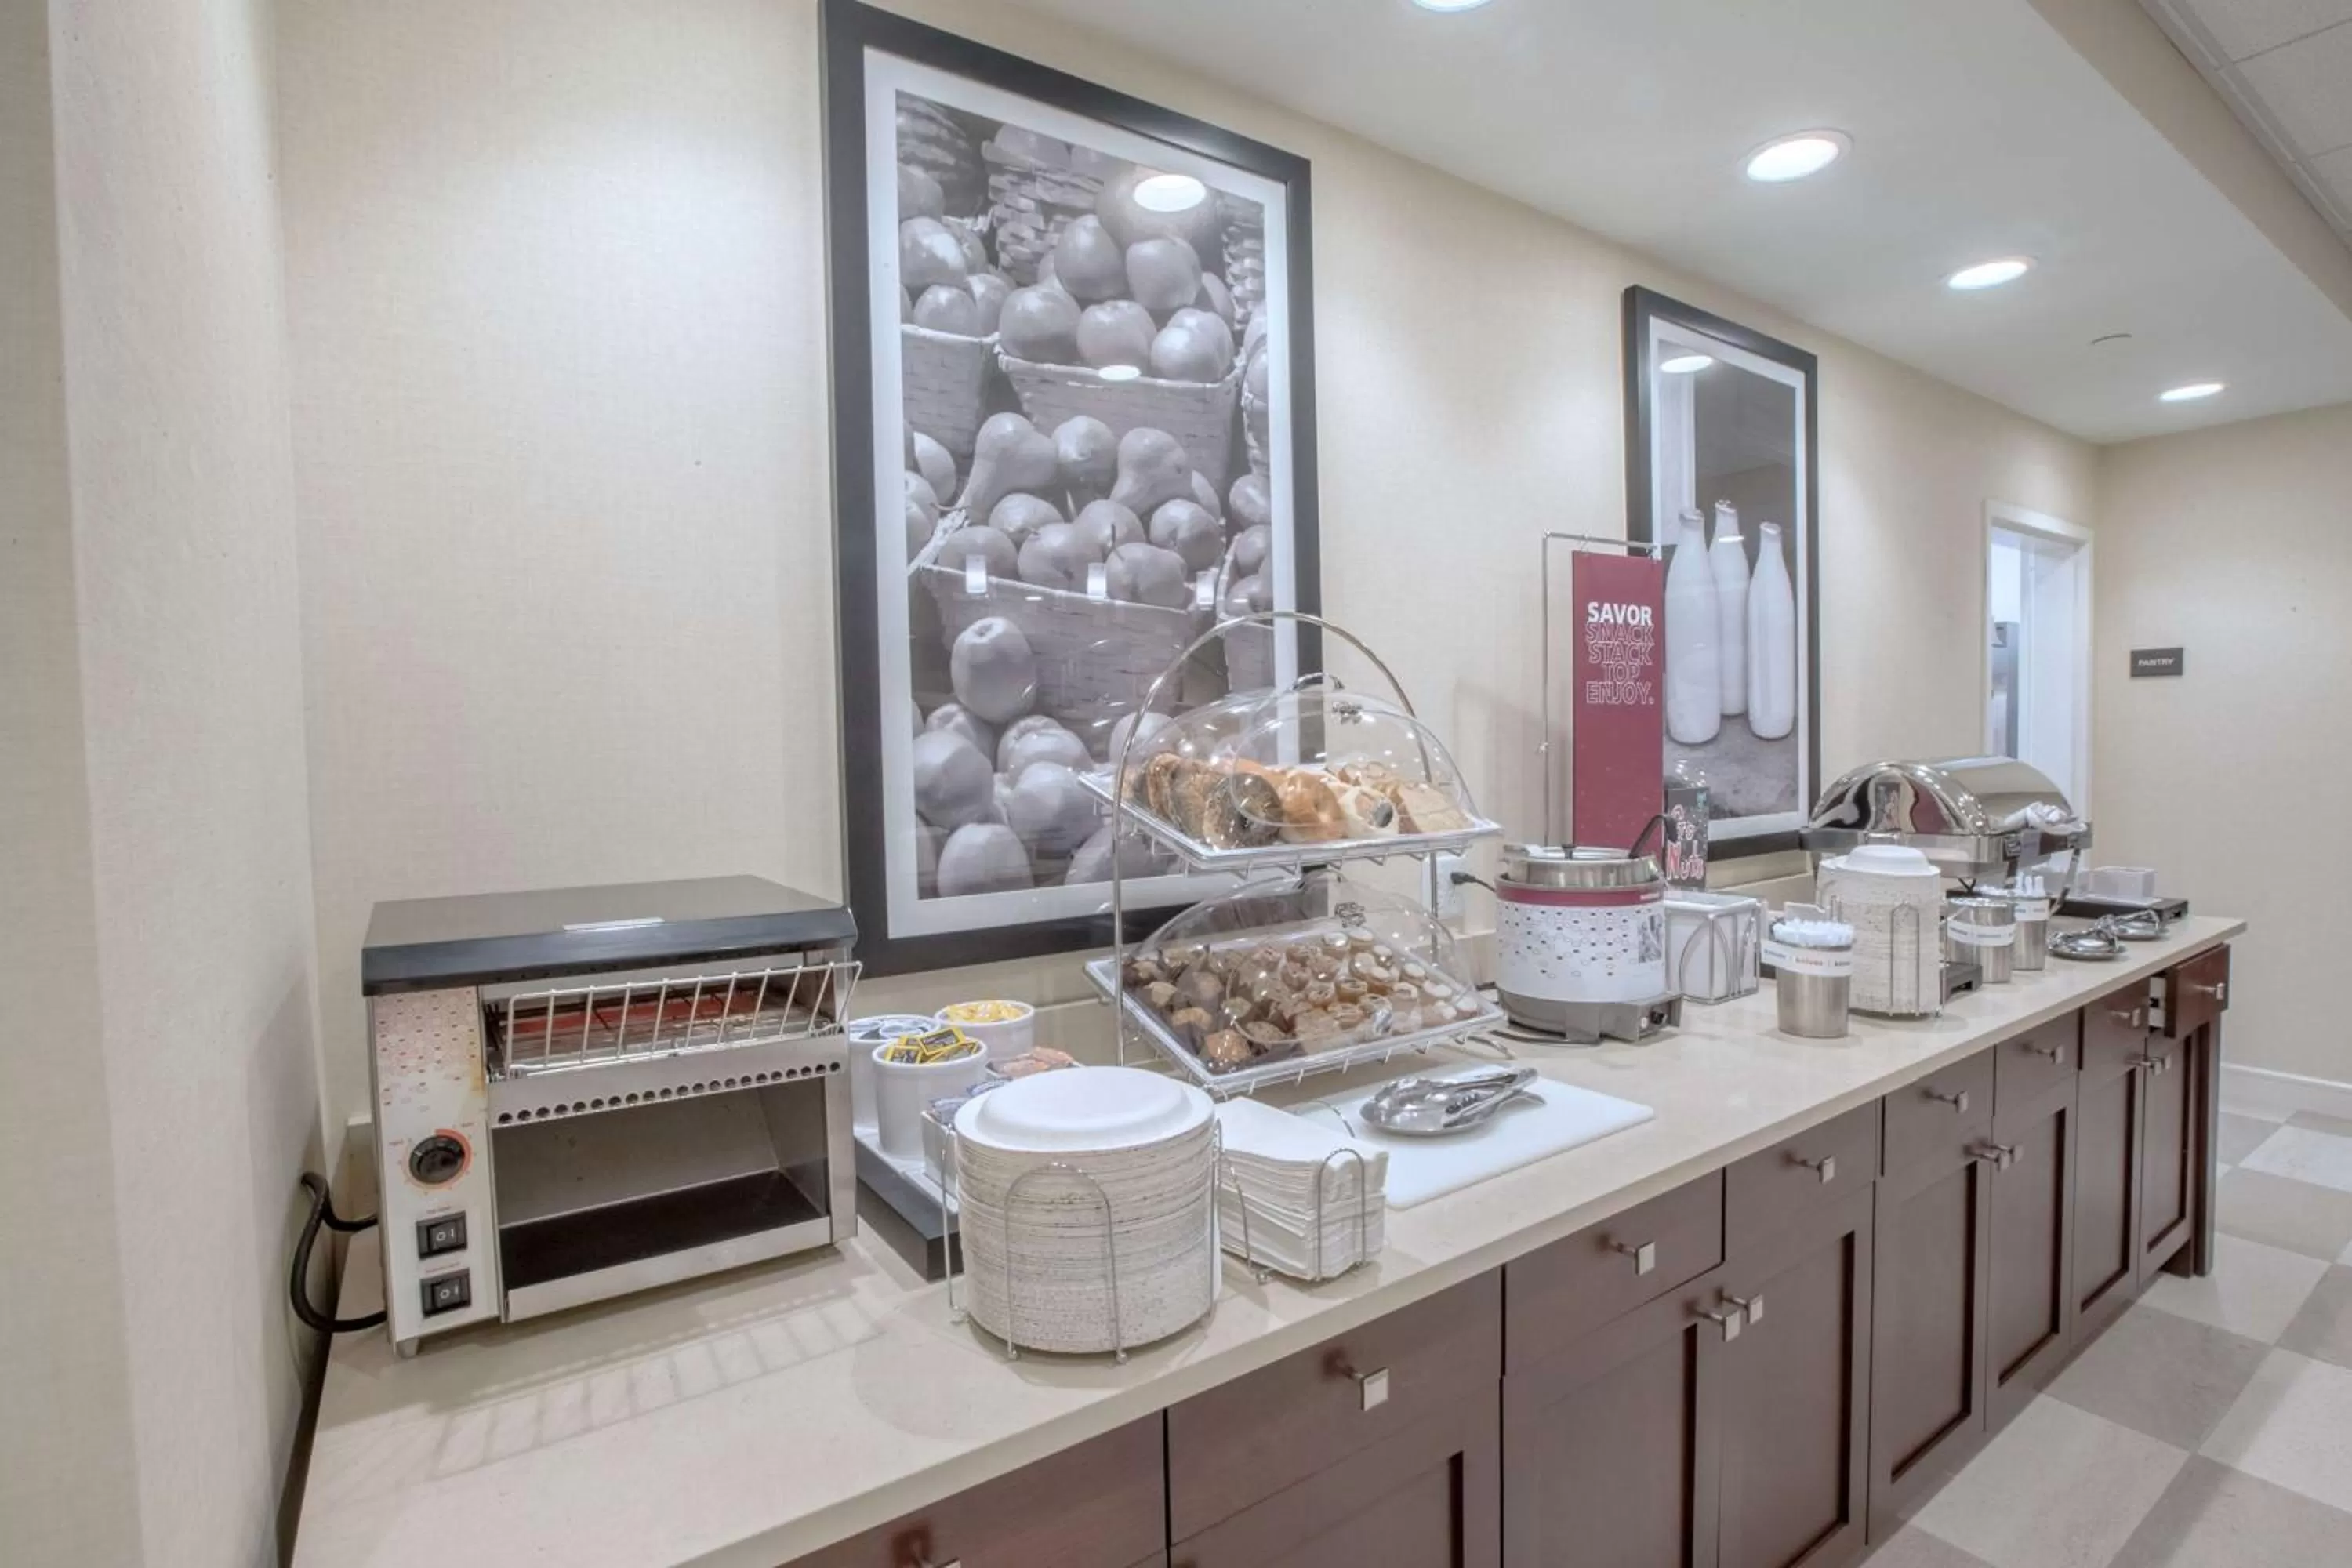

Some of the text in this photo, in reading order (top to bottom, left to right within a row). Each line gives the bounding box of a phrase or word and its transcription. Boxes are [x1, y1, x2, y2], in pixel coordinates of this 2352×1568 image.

[1587, 601, 1653, 626] SAVOR
[1588, 641, 1653, 666] STACK
[1602, 661, 1641, 684] TOP
[1586, 681, 1655, 705] ENJOY.
